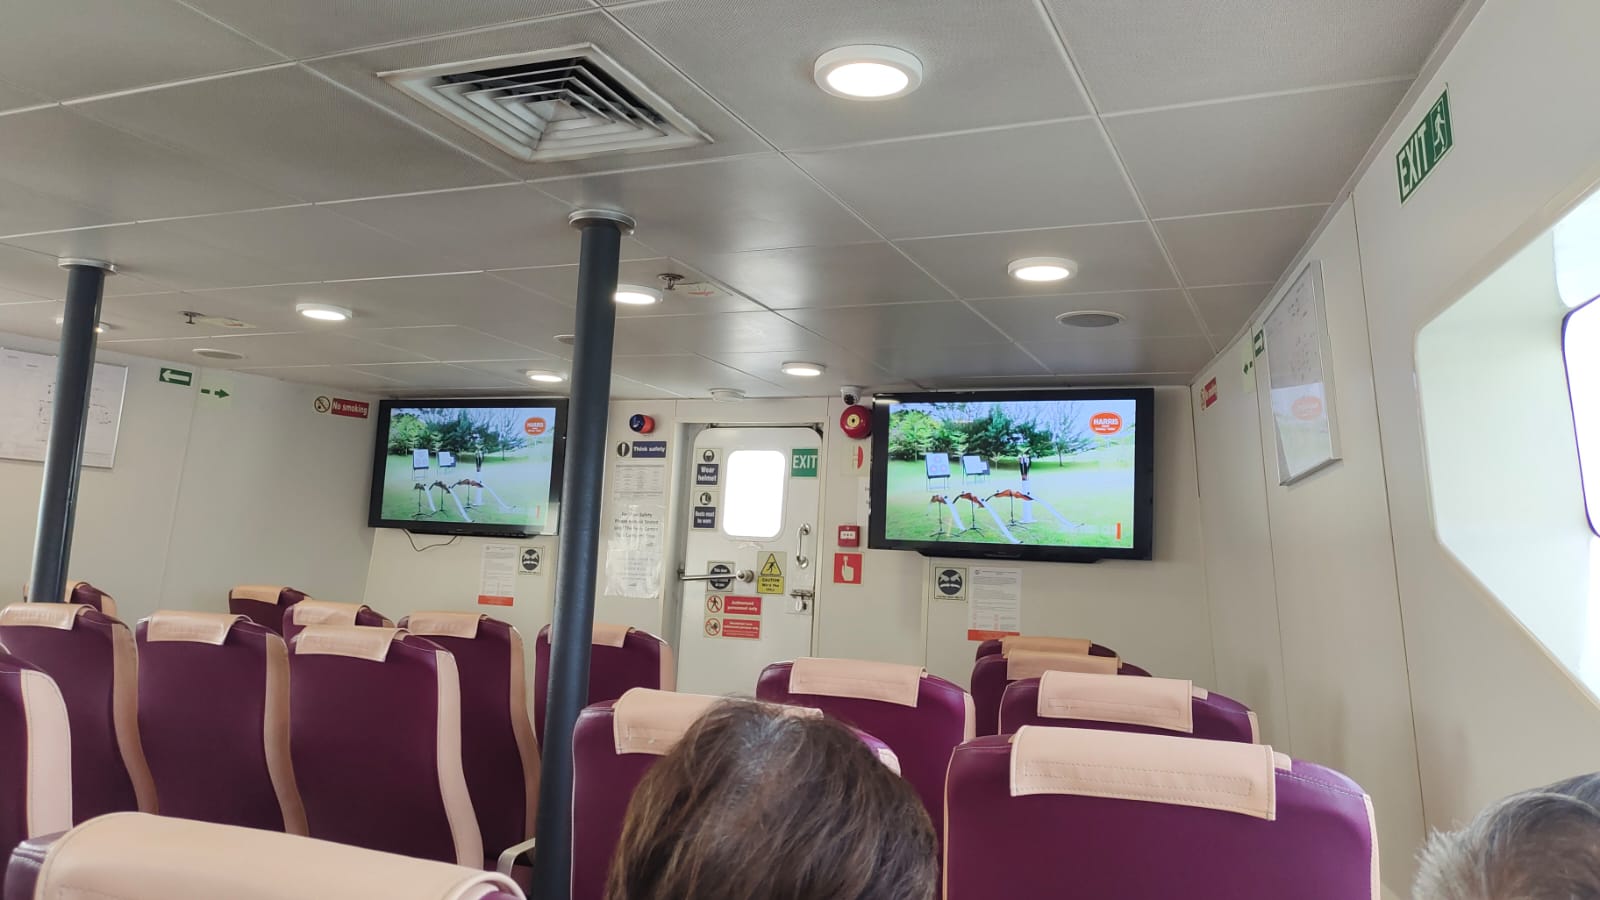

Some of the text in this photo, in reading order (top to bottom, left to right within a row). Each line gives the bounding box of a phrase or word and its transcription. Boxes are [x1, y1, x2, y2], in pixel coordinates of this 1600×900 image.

[1398, 122, 1428, 197] EXIT
[332, 401, 368, 416] No smoking
[792, 454, 818, 469] EXIT
